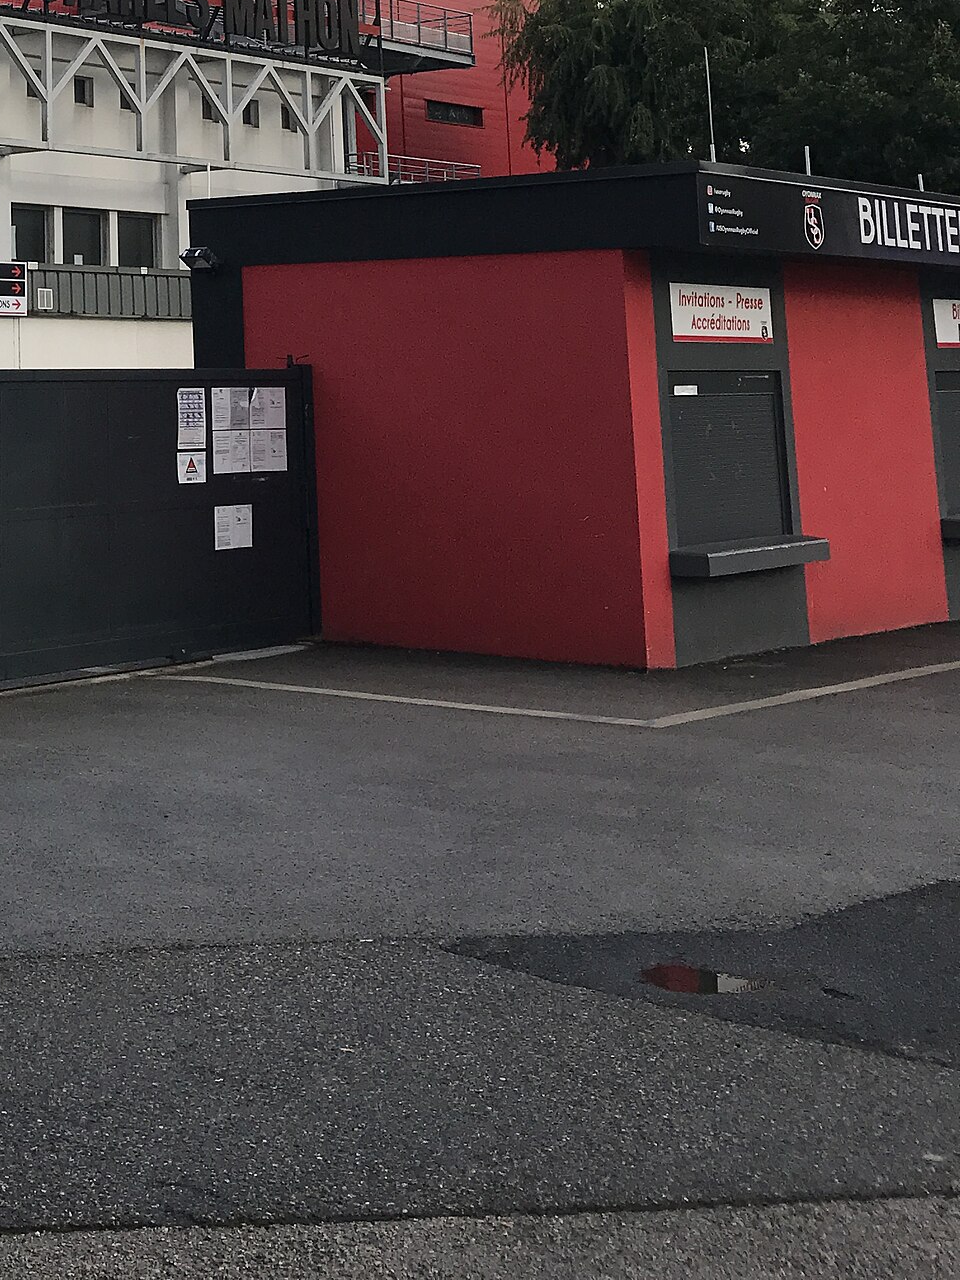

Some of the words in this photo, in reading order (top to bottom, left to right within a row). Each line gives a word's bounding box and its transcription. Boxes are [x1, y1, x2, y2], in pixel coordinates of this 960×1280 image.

[858, 196, 960, 253] BILLETTE
[679, 289, 725, 308] Invitations
[736, 292, 763, 310] Presse
[691, 313, 750, 331] Accréditations
